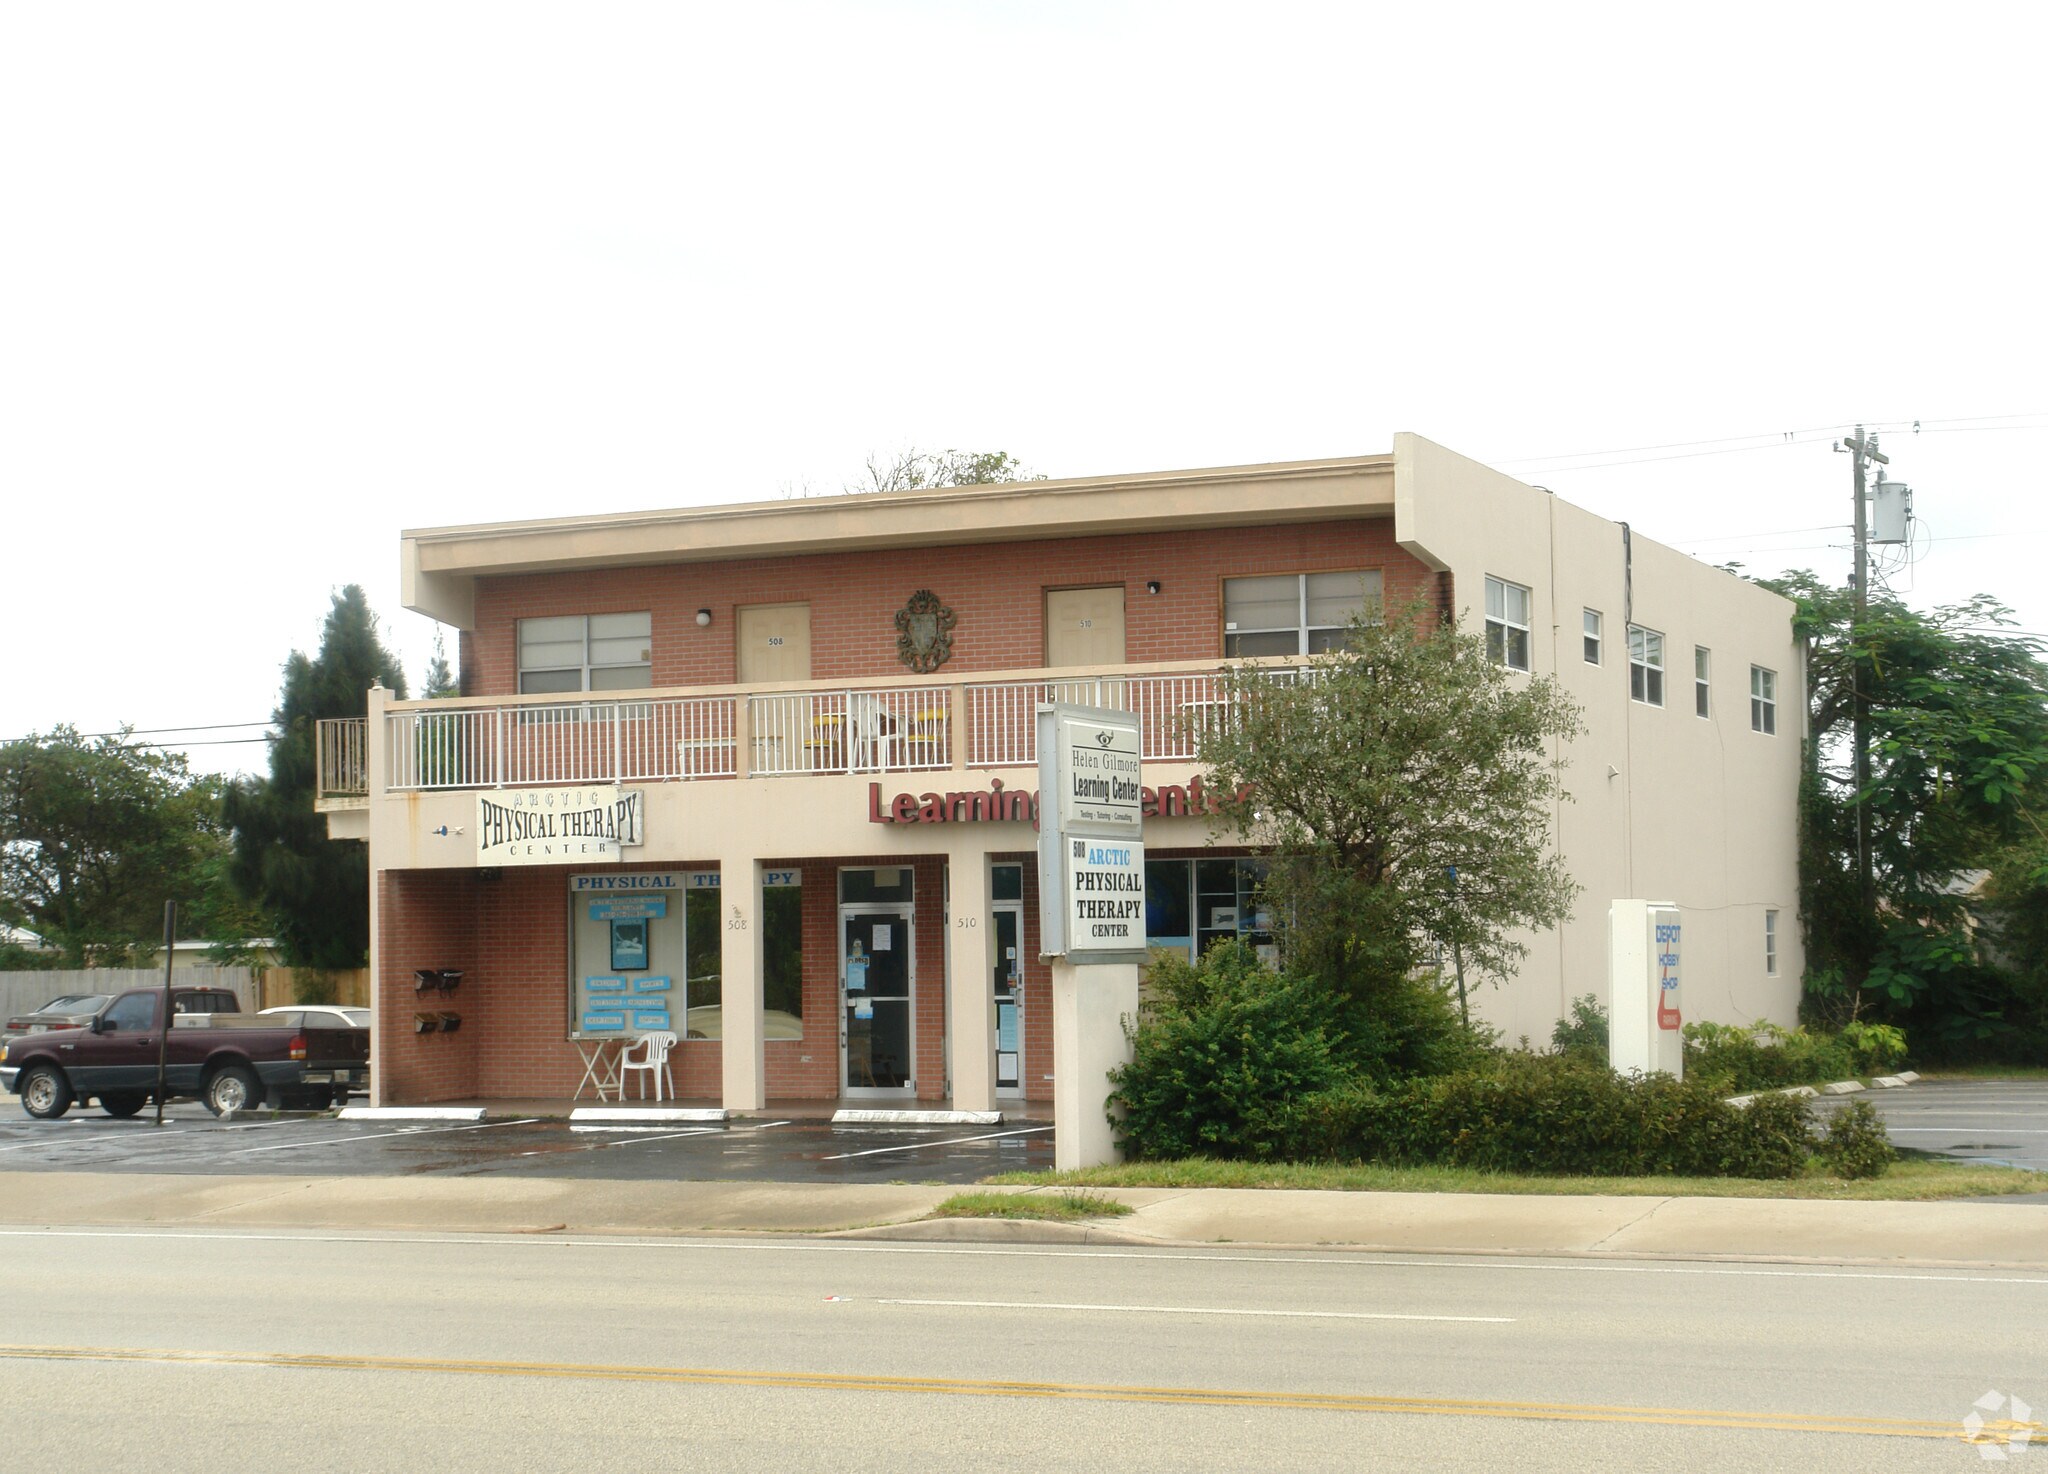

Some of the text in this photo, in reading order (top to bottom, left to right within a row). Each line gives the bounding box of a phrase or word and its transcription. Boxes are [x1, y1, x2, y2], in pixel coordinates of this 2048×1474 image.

[1079, 618, 1092, 628] 510
[768, 637, 784, 646] 508
[1072, 750, 1138, 773] Helen Gilmore
[1073, 772, 1139, 803] Learning Center
[513, 791, 599, 808] ARCTIC
[869, 778, 1040, 833] Learnin
[481, 792, 638, 850] PHYSICAL THERAPY
[1080, 810, 1133, 823] Testing Tutoring Consulting
[510, 842, 606, 856] CENTER
[1073, 841, 1131, 866] 508 ARCTIC
[577, 874, 677, 889] PHYSICAL
[1075, 872, 1142, 892] PHYSICAL
[1076, 900, 1142, 919] THERAPY
[728, 920, 747, 930] 508
[957, 917, 977, 928] 510
[1091, 924, 1129, 938] CENTER
[1656, 925, 1681, 943] DEPOT
[1659, 953, 1680, 967] HOBBY
[1662, 977, 1679, 989] SHOP
